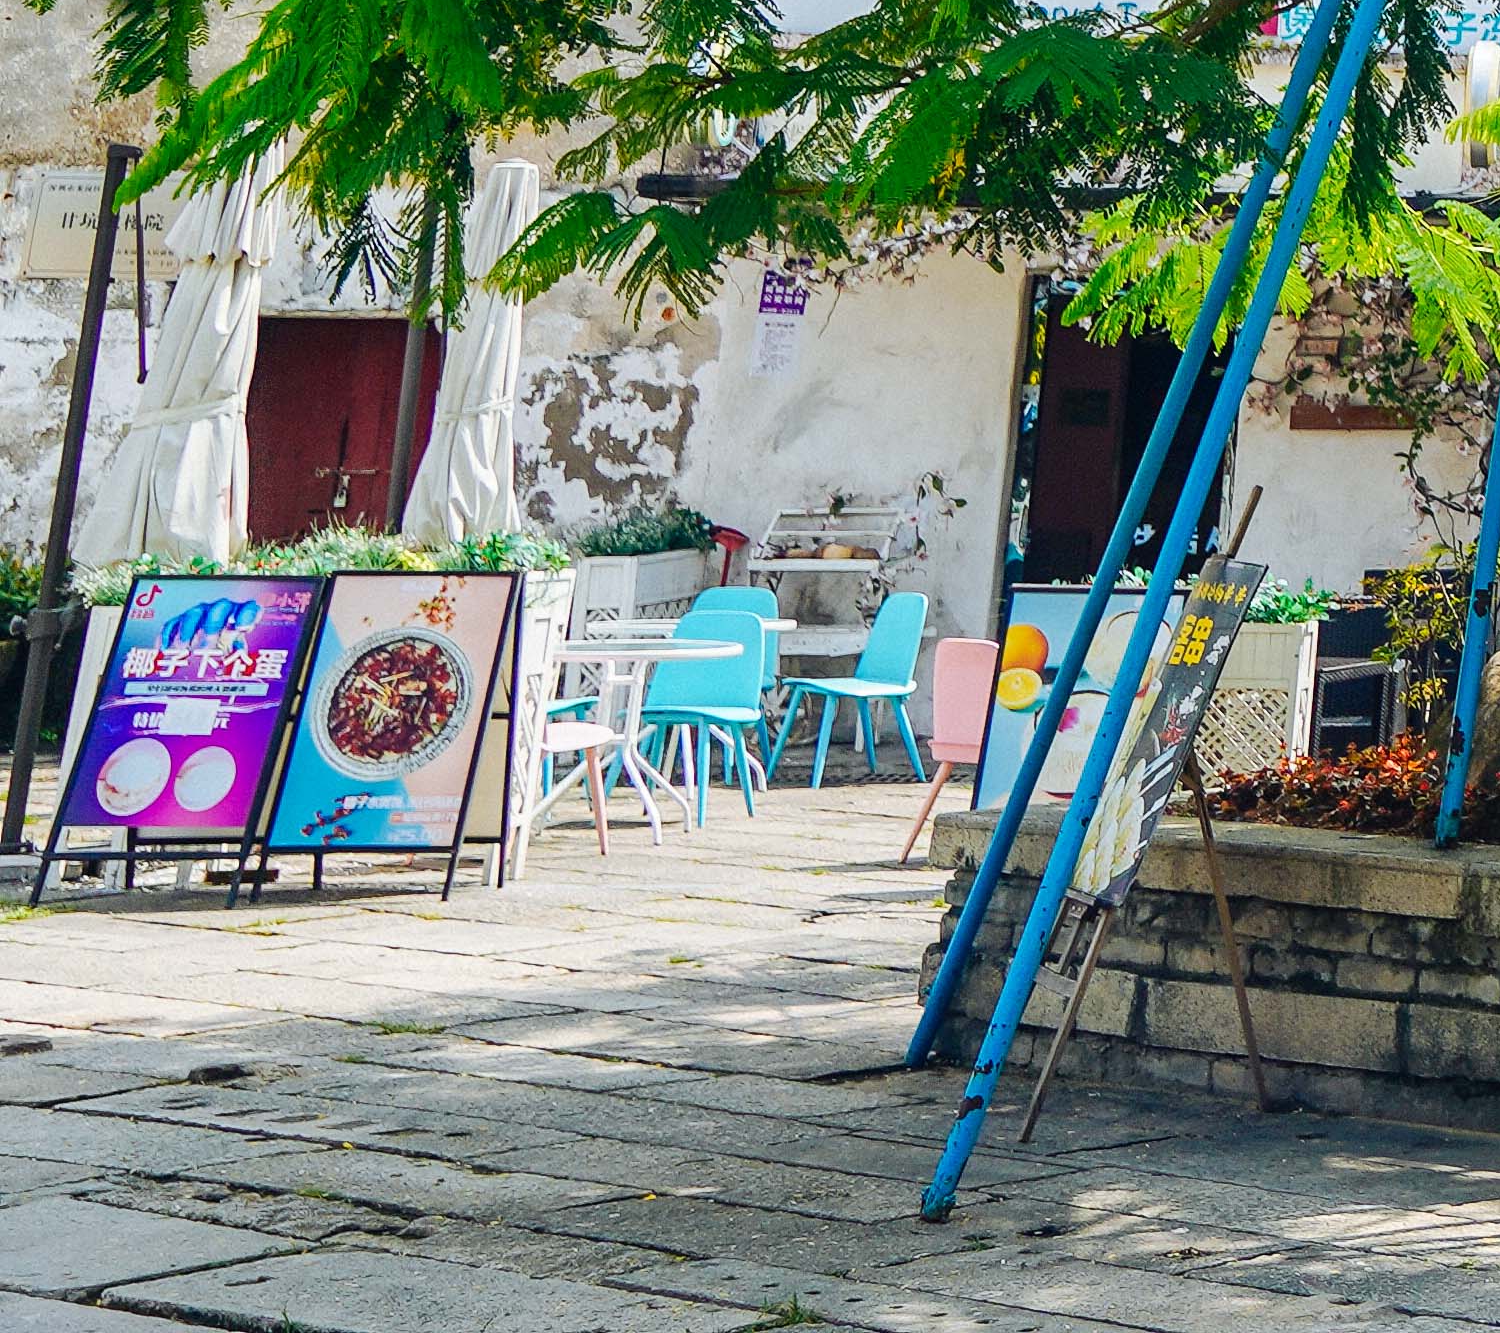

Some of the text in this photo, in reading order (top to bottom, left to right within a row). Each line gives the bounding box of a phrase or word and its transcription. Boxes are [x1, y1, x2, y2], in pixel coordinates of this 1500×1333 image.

[122, 647, 289, 680] 椰子下个蛋
